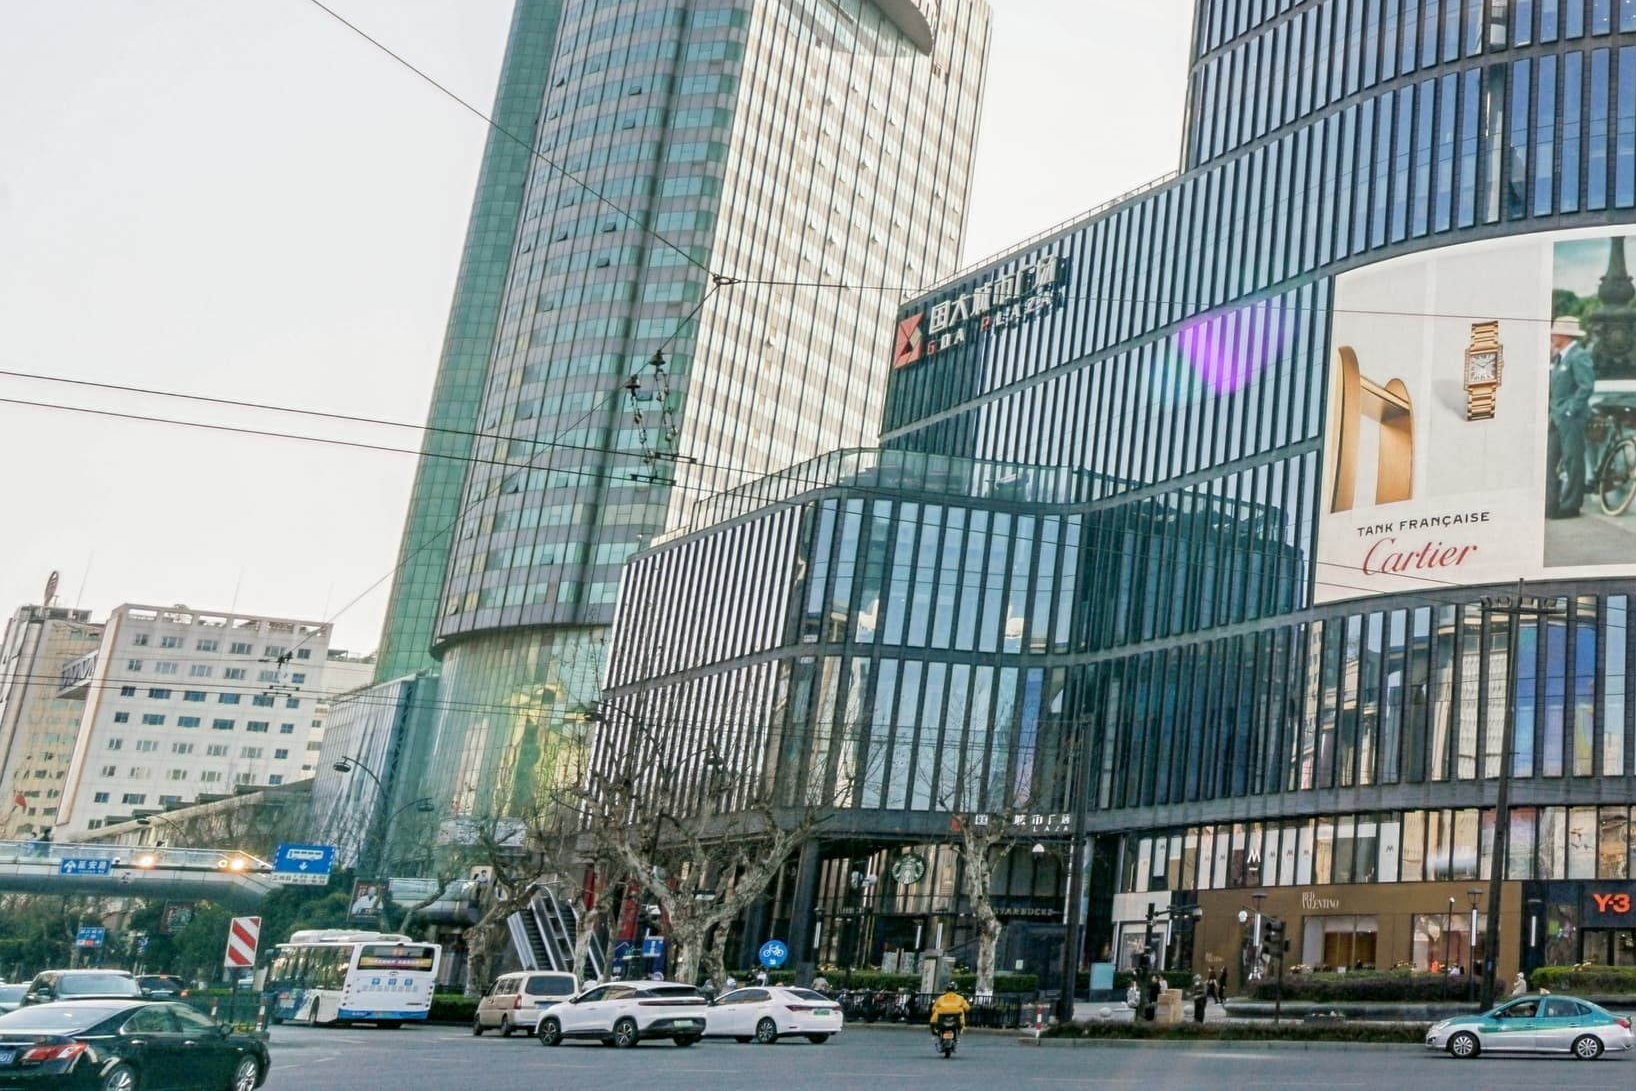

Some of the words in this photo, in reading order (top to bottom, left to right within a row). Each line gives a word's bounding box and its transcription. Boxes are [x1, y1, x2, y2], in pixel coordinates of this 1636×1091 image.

[927, 327, 966, 356] GDA
[1357, 523, 1393, 537] TANK
[1399, 511, 1491, 531] FRANÇAISE
[1362, 537, 1479, 576] Cartier
[975, 814, 1071, 826] 国城市广场
